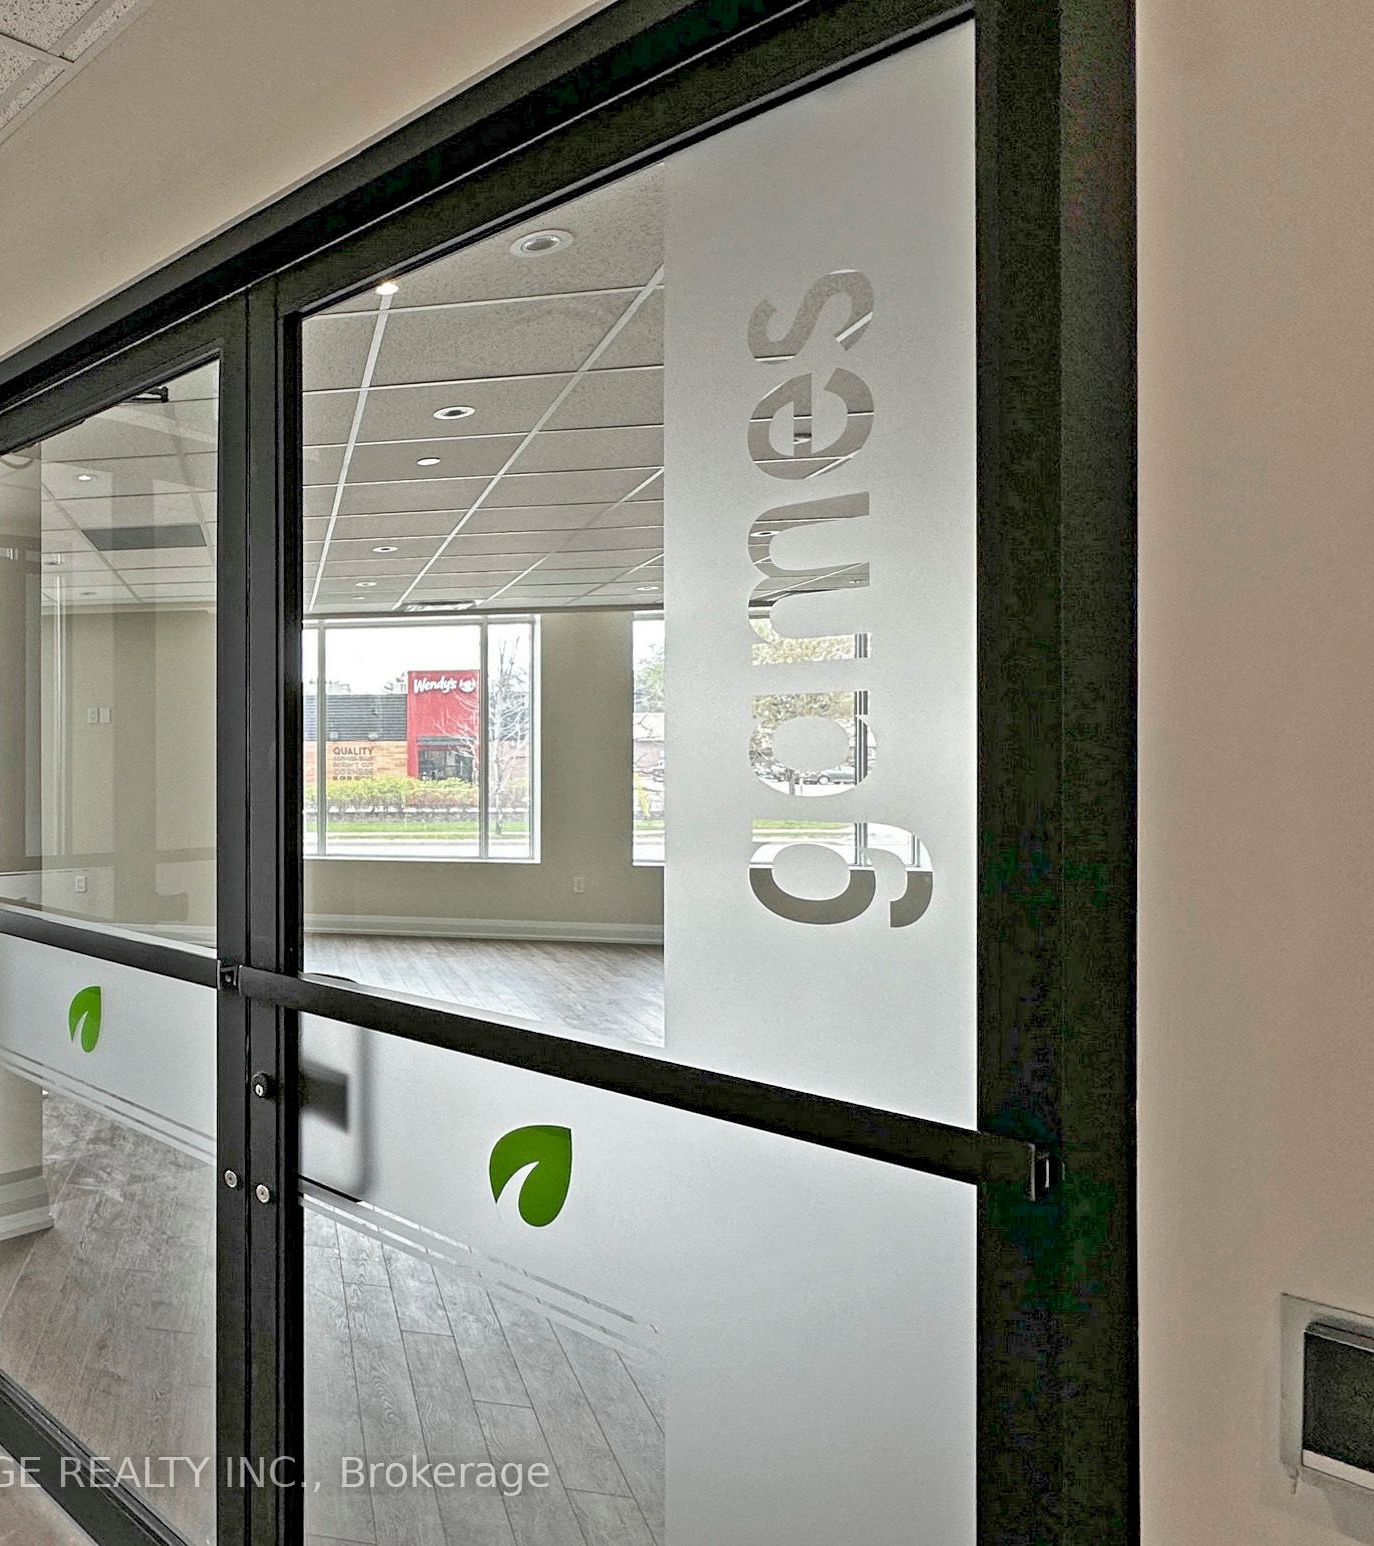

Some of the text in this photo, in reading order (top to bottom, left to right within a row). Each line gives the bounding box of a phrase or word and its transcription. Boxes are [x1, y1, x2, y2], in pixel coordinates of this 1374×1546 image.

[747, 267, 933, 929] games
[413, 675, 457, 694] Wendy's
[332, 746, 374, 756] QUALITY
